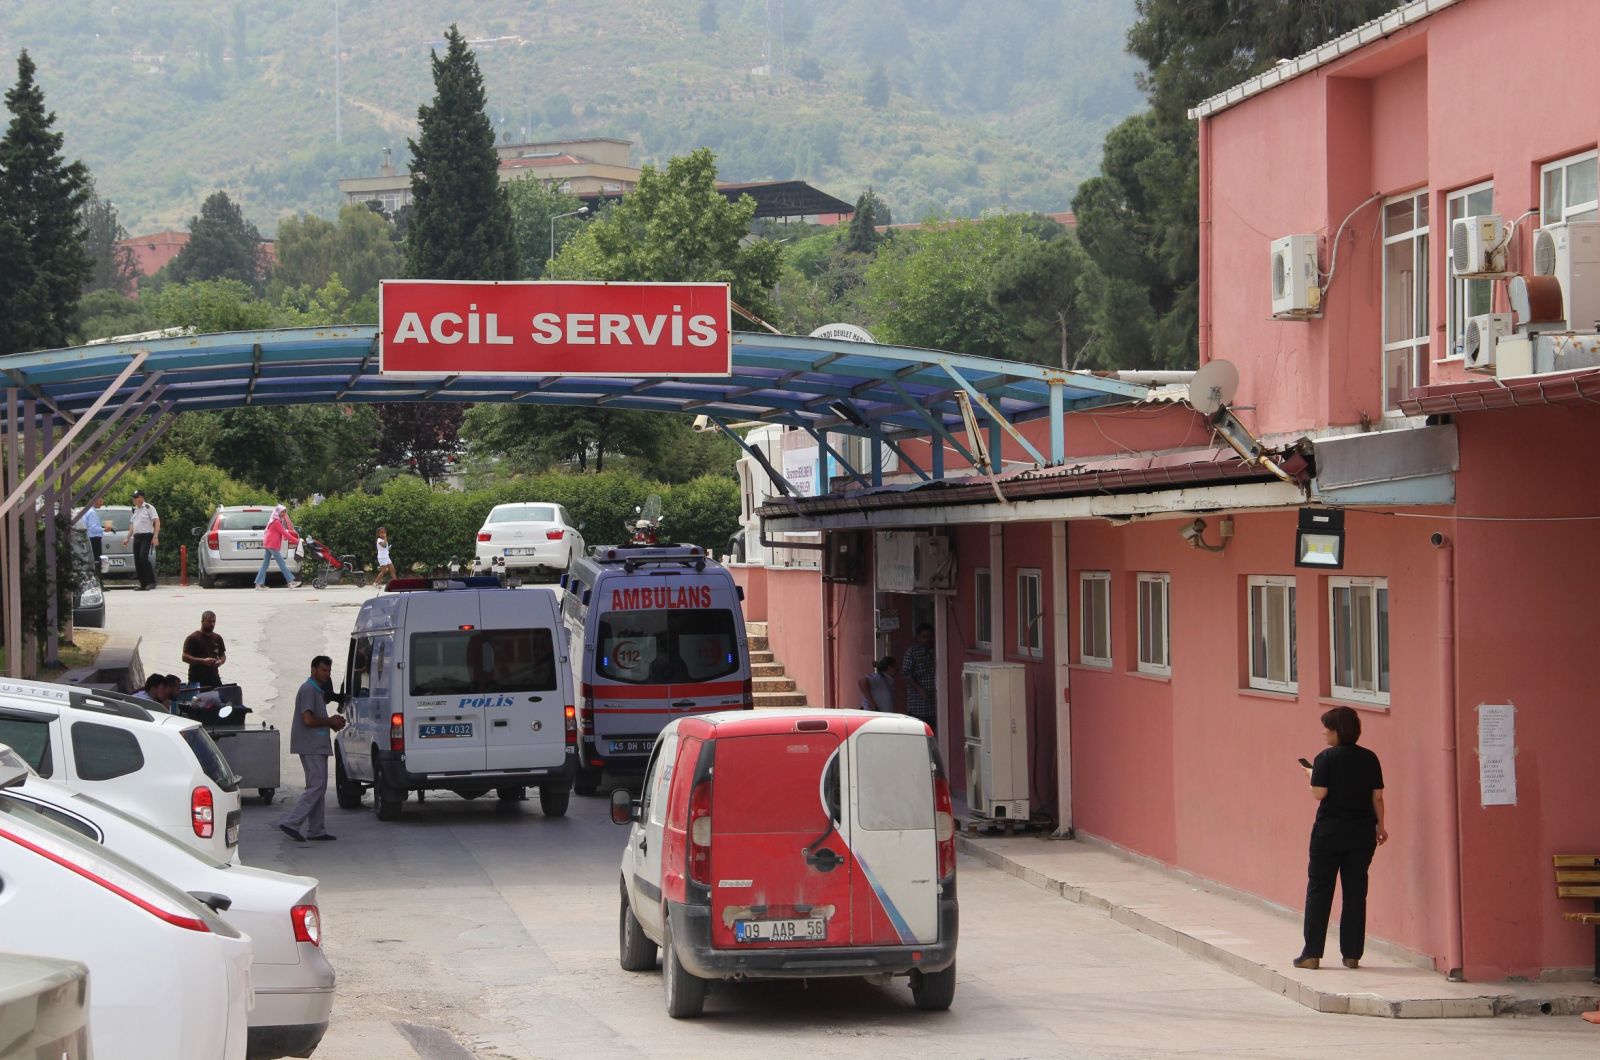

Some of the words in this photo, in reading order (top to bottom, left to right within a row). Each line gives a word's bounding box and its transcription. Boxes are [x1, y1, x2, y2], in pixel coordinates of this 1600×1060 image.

[392, 303, 514, 345] ACİL
[531, 304, 718, 347] SERVİS
[833, 329, 853, 339] DEVLET
[611, 585, 712, 611] AMBULANS
[620, 650, 641, 663] 112
[458, 694, 515, 709] POLİS
[425, 726, 436, 735] 45
[441, 725, 446, 734] A
[449, 725, 470, 734] 4032
[614, 741, 624, 750] 45
[628, 741, 638, 750] DH
[744, 924, 760, 938] 09
[772, 922, 796, 938] AAB
[807, 921, 823, 935] 56
